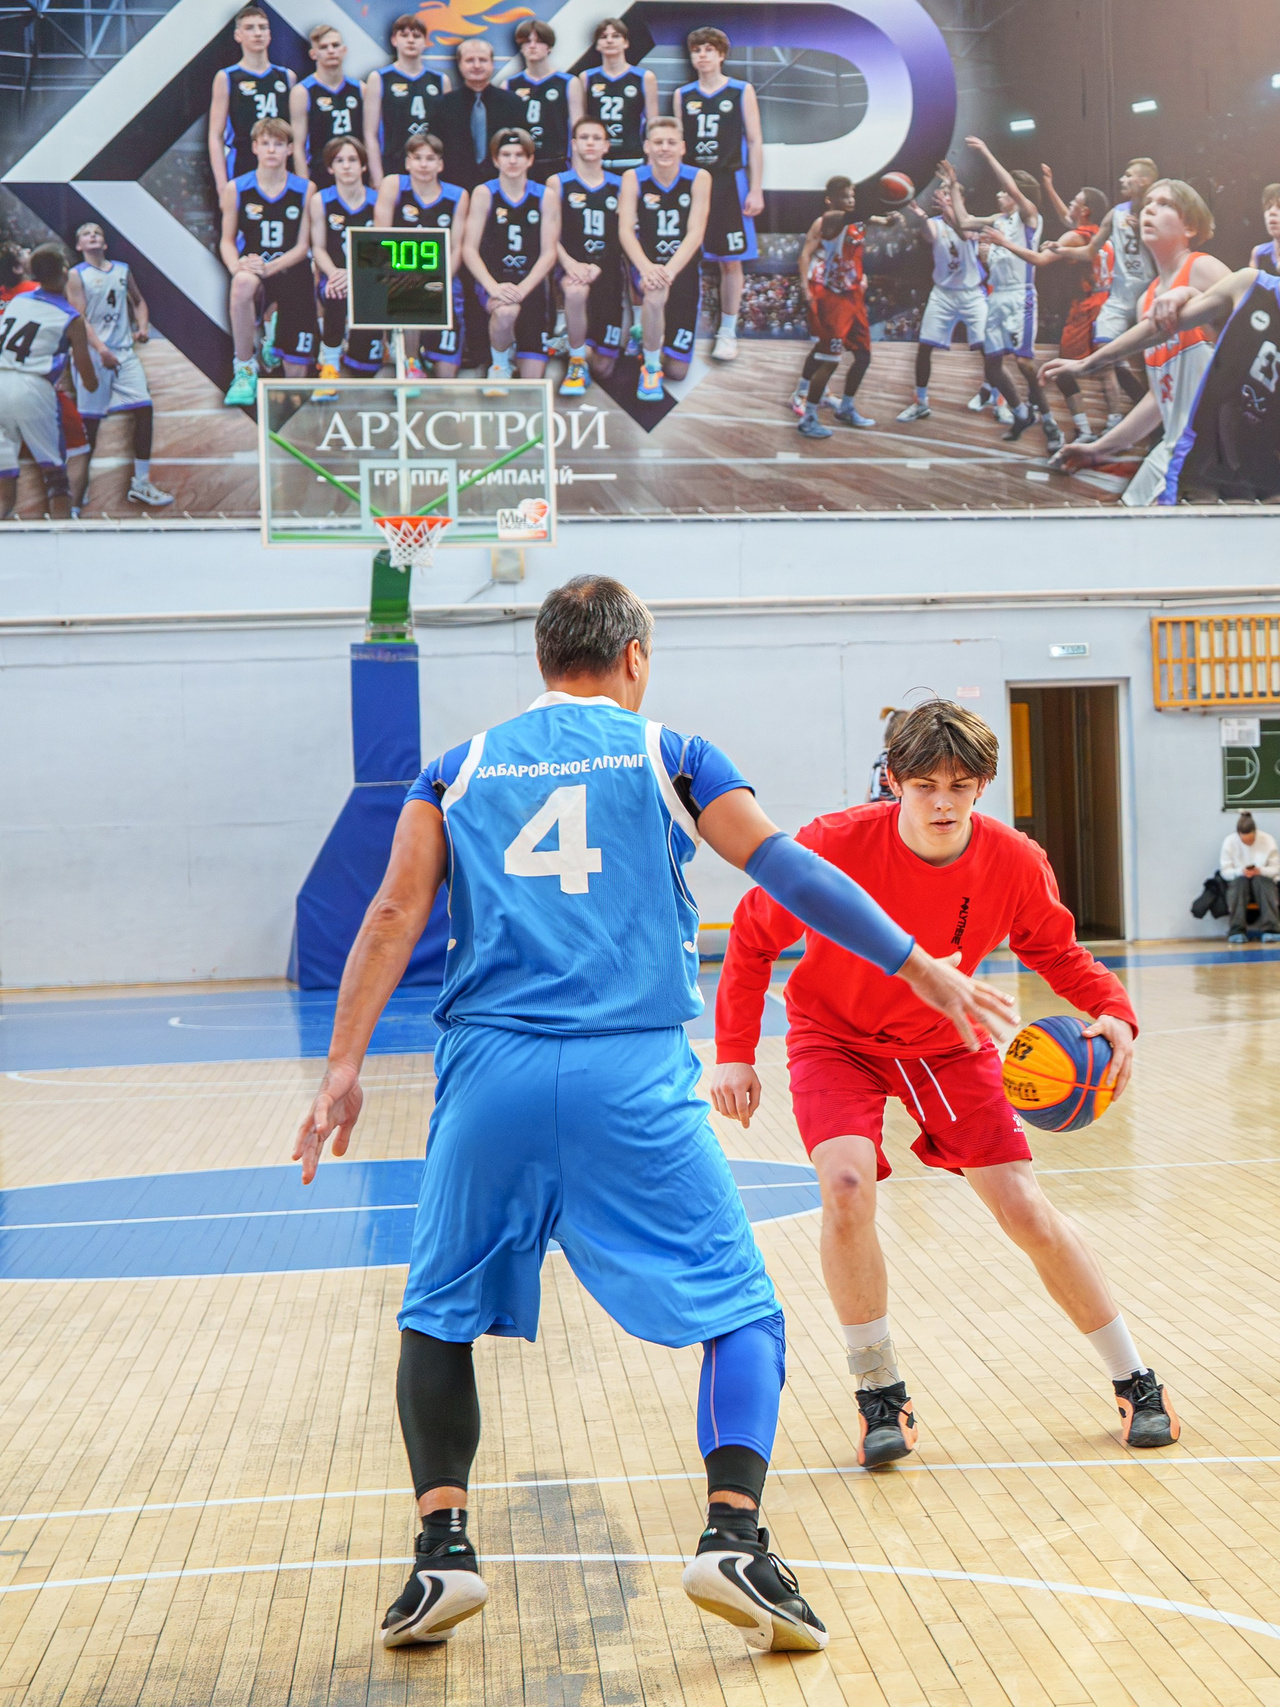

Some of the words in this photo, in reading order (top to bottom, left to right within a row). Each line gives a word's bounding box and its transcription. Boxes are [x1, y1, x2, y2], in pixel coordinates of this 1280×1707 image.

[254, 92, 278, 119] 34
[411, 95, 426, 120] 4
[526, 99, 541, 124] 8
[600, 96, 624, 120] 22
[331, 108, 352, 135] 23
[697, 113, 720, 138] 15
[260, 220, 284, 248] 13
[582, 208, 605, 237] 19
[656, 209, 681, 237] 12
[508, 224, 523, 252] 5
[726, 231, 745, 251] 15
[296, 331, 314, 353] 13
[439, 329, 456, 351] 11
[672, 328, 693, 350] 12
[316, 403, 610, 450] АРХСТРОЙ
[374, 468, 450, 486] ГРППА
[476, 757, 590, 779] ХАБАРОВСКОЕ
[591, 754, 649, 771] ЛПУМГ
[504, 783, 602, 895] 4
